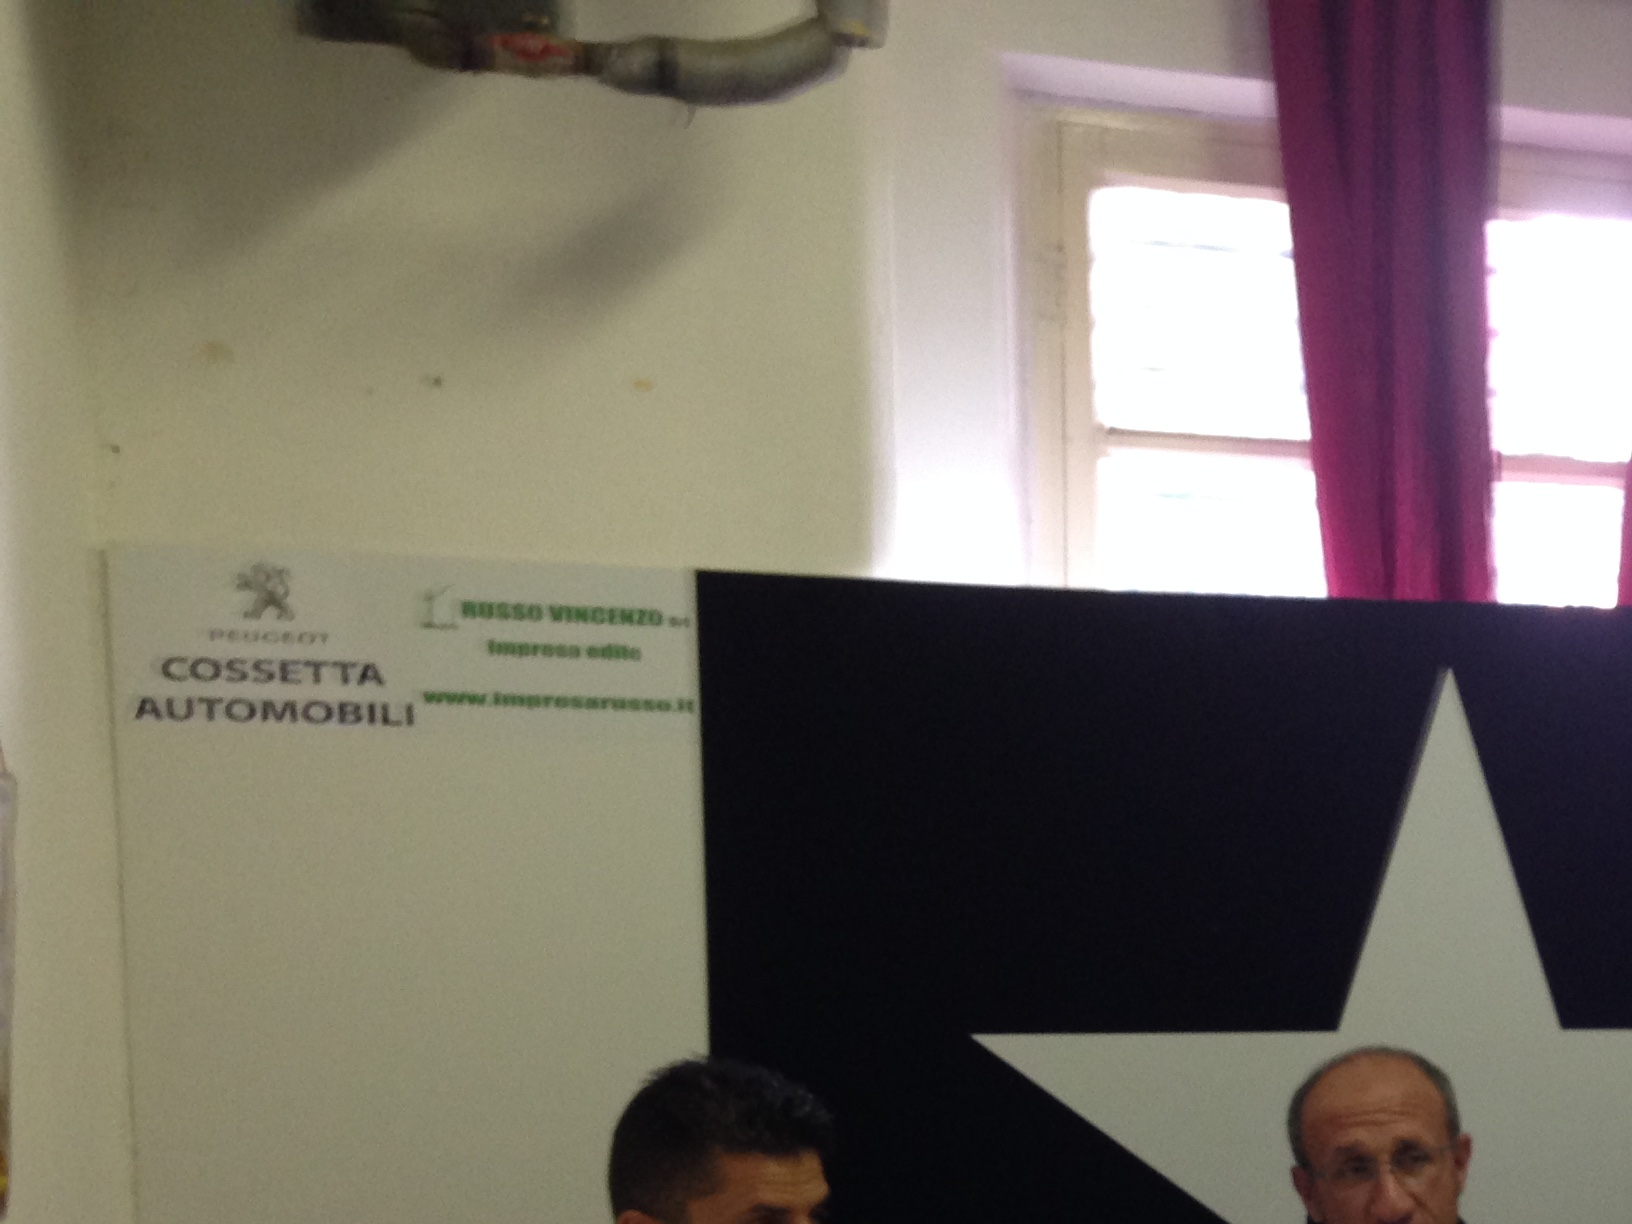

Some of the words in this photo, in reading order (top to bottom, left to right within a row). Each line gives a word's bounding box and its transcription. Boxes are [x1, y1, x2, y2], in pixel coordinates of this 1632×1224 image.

[461, 599, 542, 622] RUSSO
[548, 603, 664, 627] VINCENZO
[208, 628, 330, 646] PEUGEOT
[160, 655, 385, 687] COSSETTA
[133, 695, 416, 727] AUTOMOBILI
